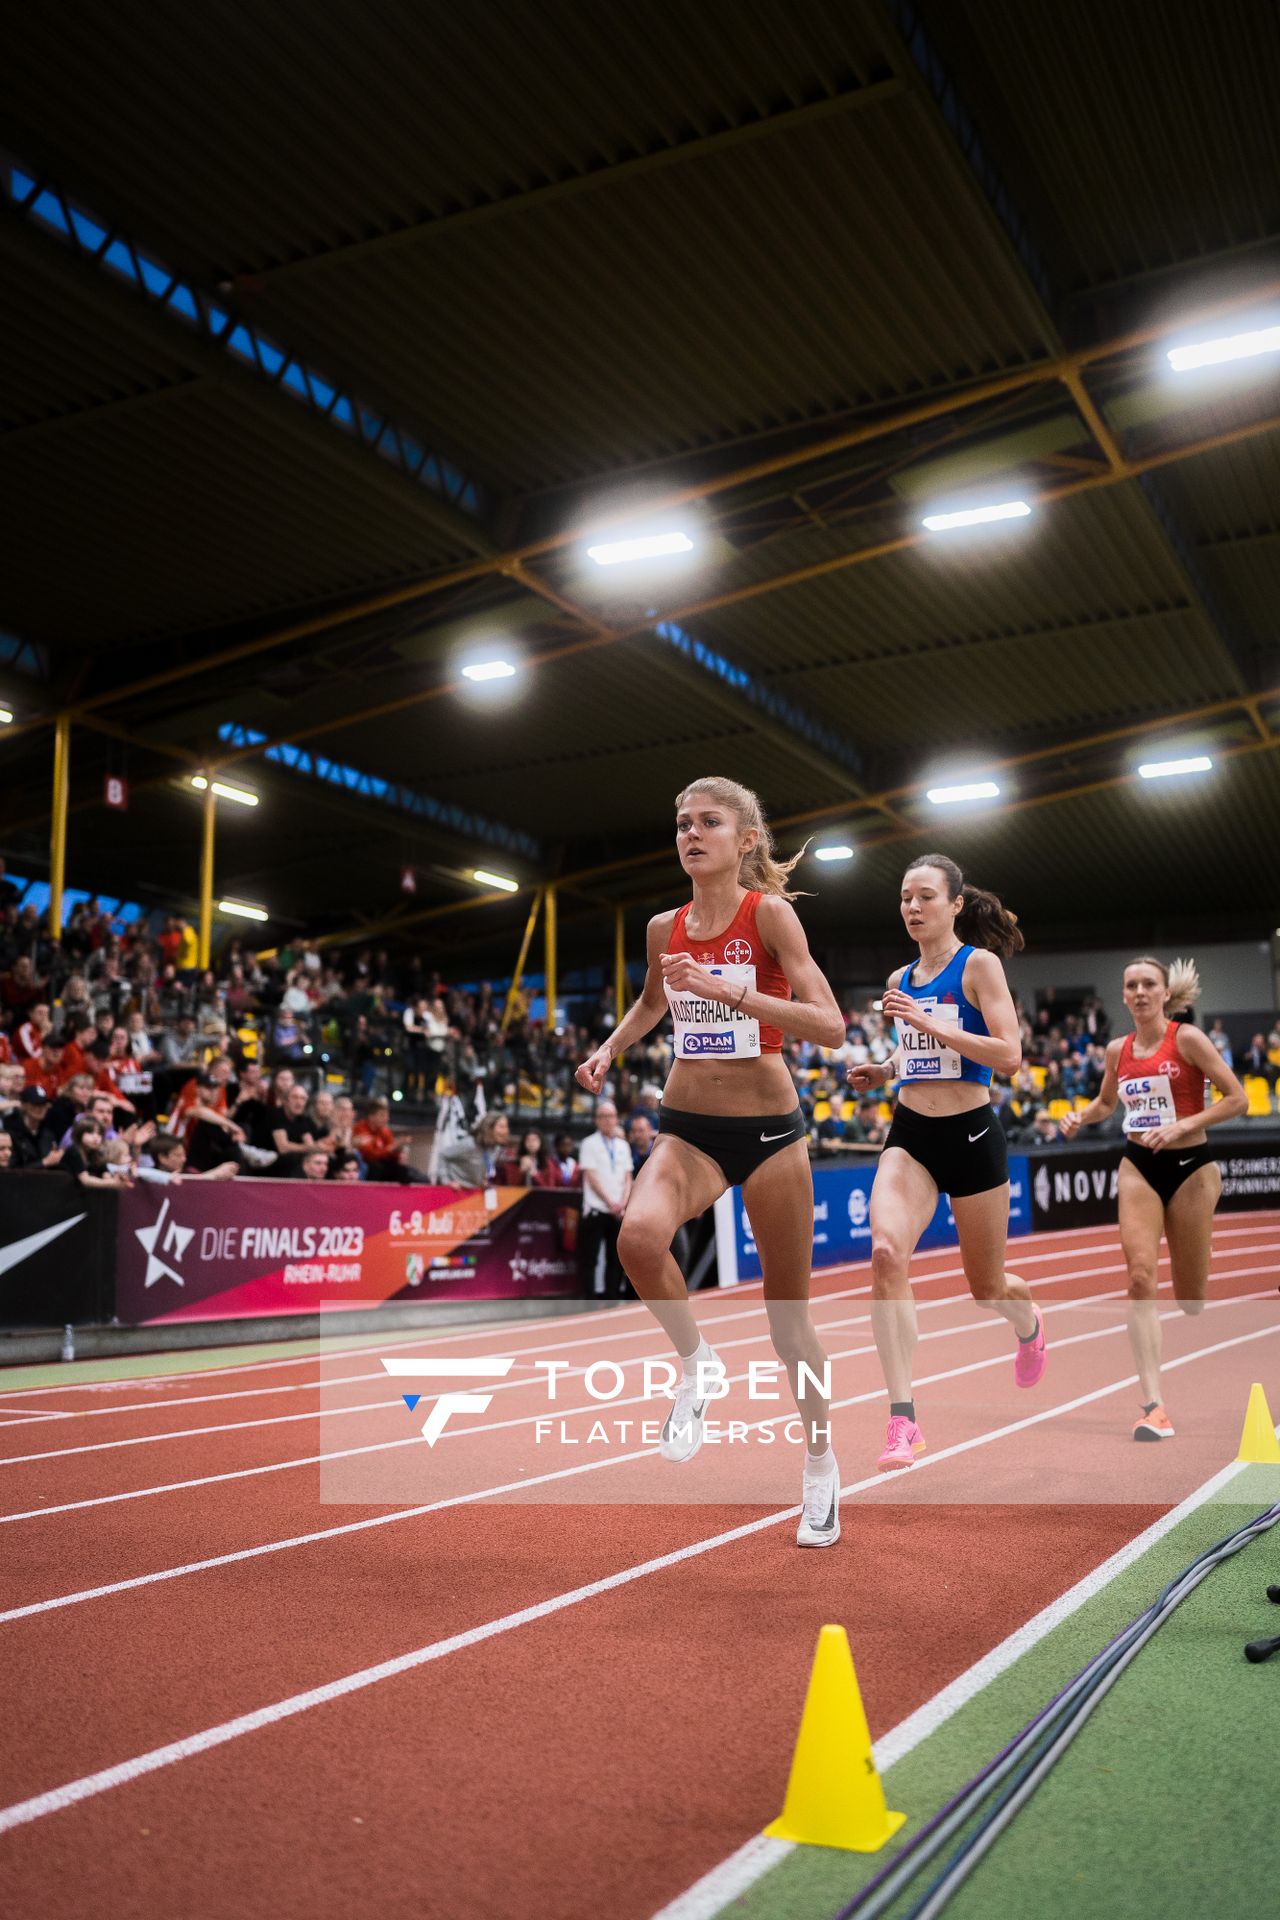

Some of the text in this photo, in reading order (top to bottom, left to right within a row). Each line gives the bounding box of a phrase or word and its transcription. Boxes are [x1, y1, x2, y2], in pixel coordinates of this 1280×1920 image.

[106, 778, 123, 805] B
[726, 949, 750, 957] BAYER
[671, 1000, 752, 1023] KLOSTERHALFE
[702, 1036, 733, 1047] PLAN
[916, 1060, 939, 1069] PLAN
[200, 1226, 364, 1261] DIE FINALS 2023
[283, 1263, 362, 1285] RHEIN-RUHR
